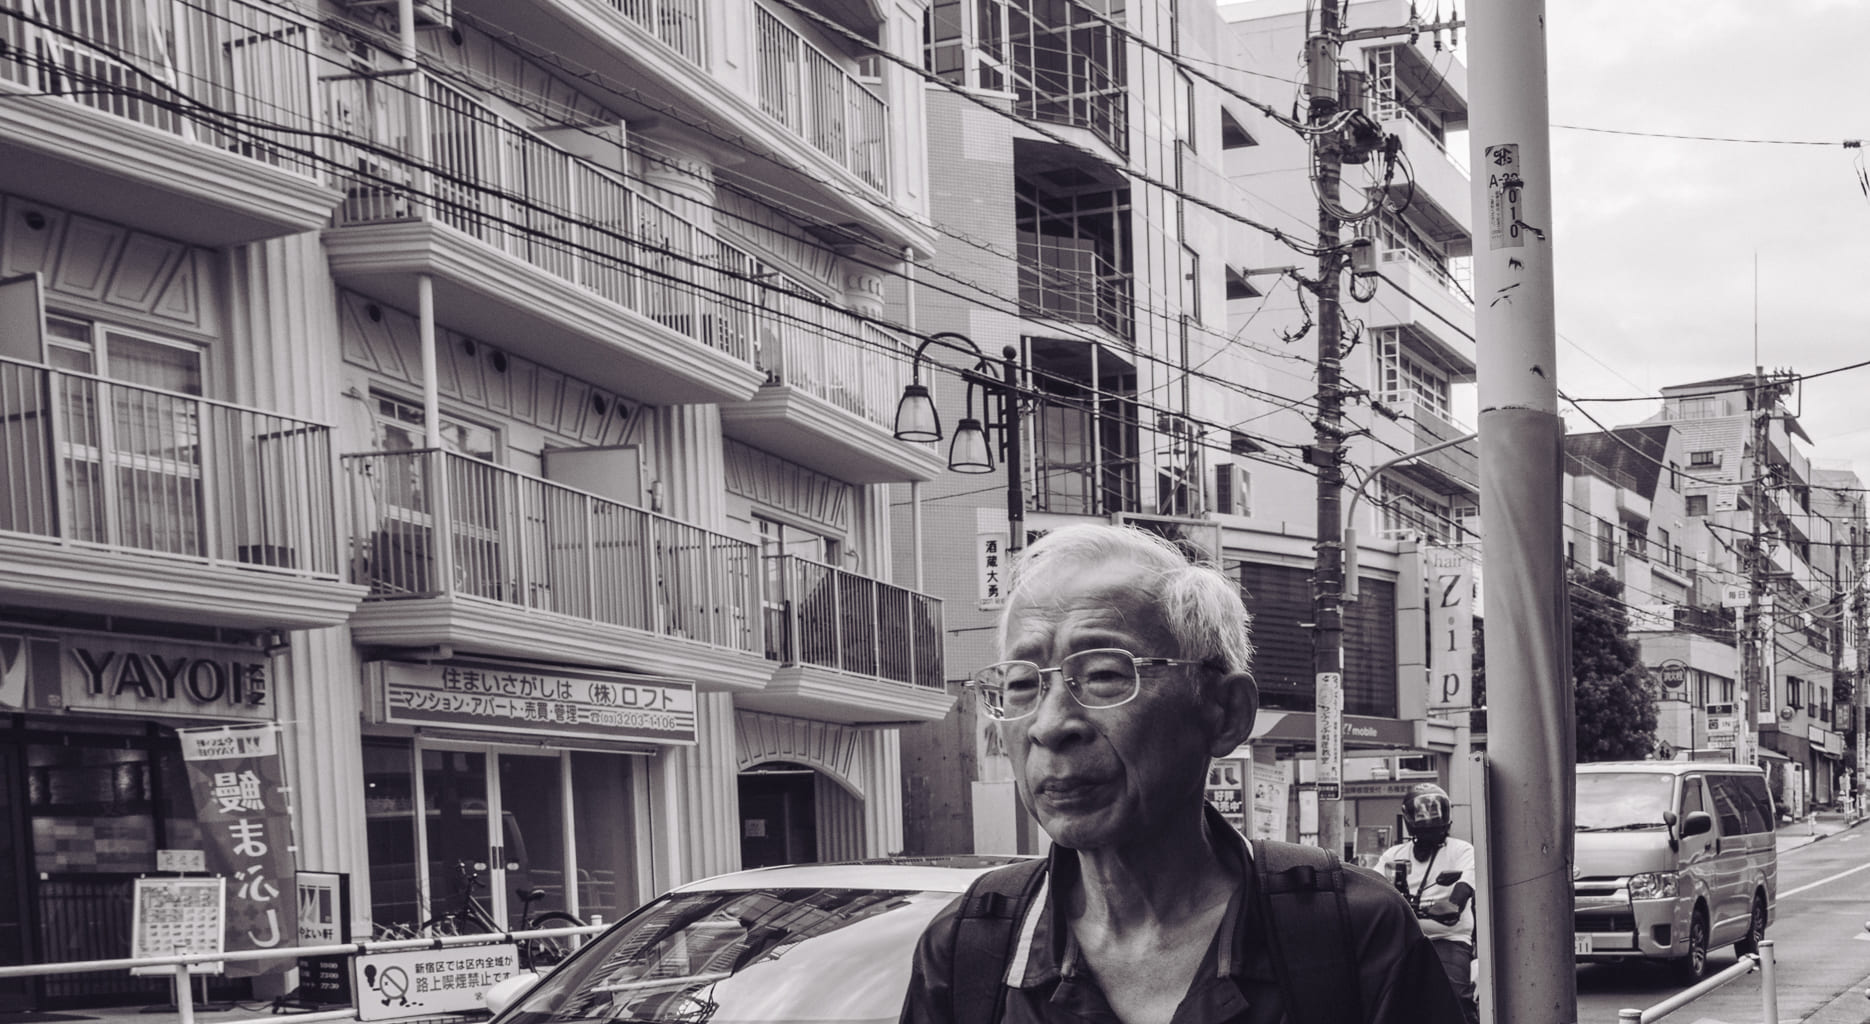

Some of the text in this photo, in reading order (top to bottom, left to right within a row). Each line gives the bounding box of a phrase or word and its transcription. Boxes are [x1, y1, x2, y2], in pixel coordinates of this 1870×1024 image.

[1433, 553, 1463, 568] hair
[72, 648, 243, 704] YAYOI
[246, 663, 266, 707] KEN
[442, 667, 573, 700] 住まいさがしは
[415, 955, 514, 974] 新宿区では区内全域が
